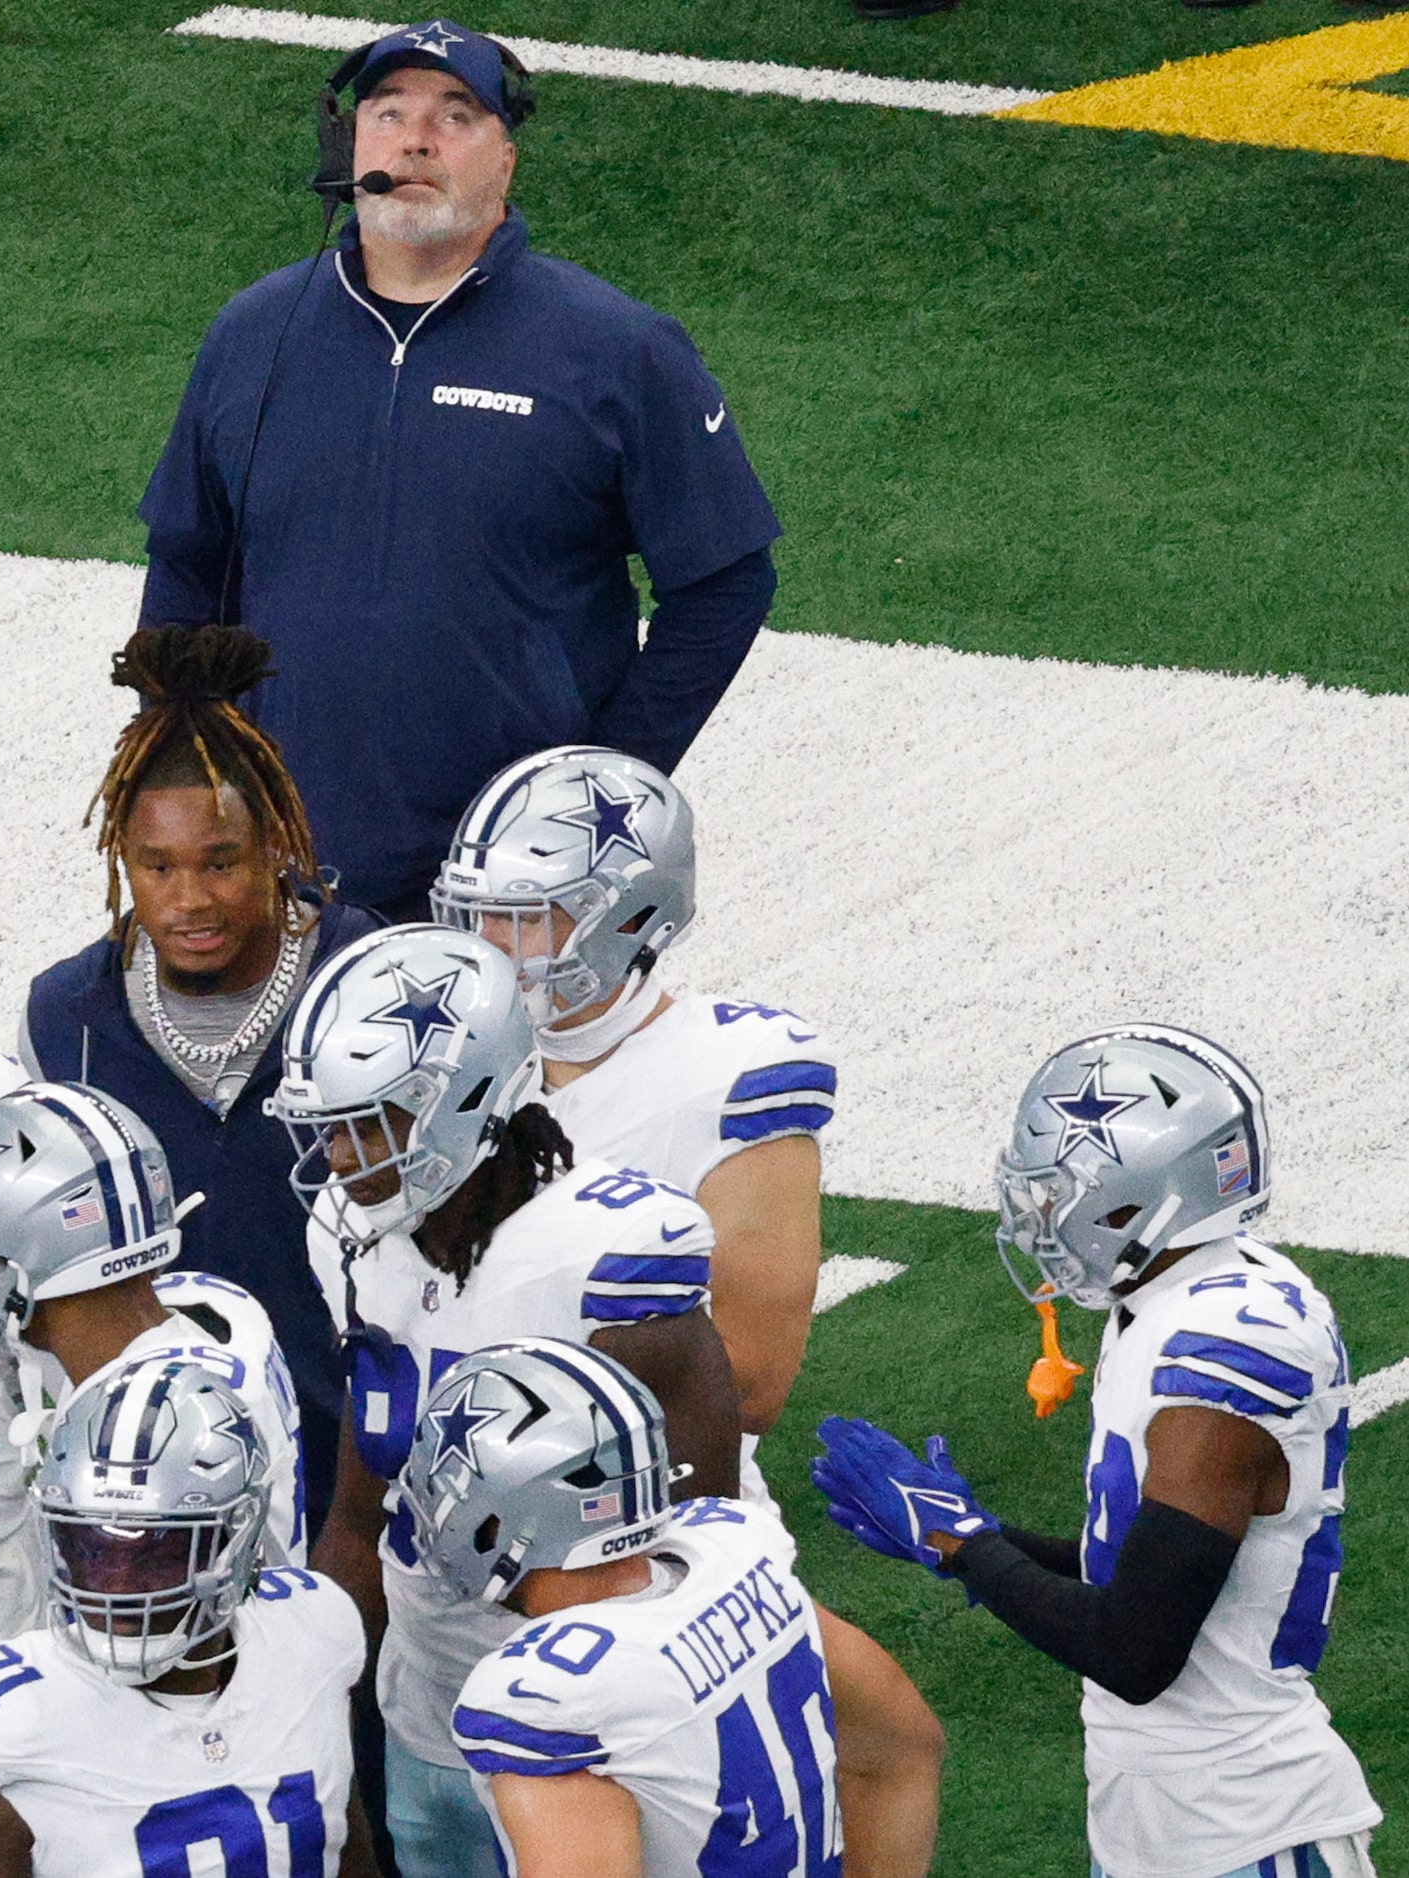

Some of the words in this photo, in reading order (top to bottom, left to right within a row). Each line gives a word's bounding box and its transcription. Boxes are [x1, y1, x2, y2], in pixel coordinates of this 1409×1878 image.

[432, 386, 534, 416] COWBOYS
[101, 1241, 170, 1278] COWBOYS
[659, 1555, 803, 1705] LUEPKE
